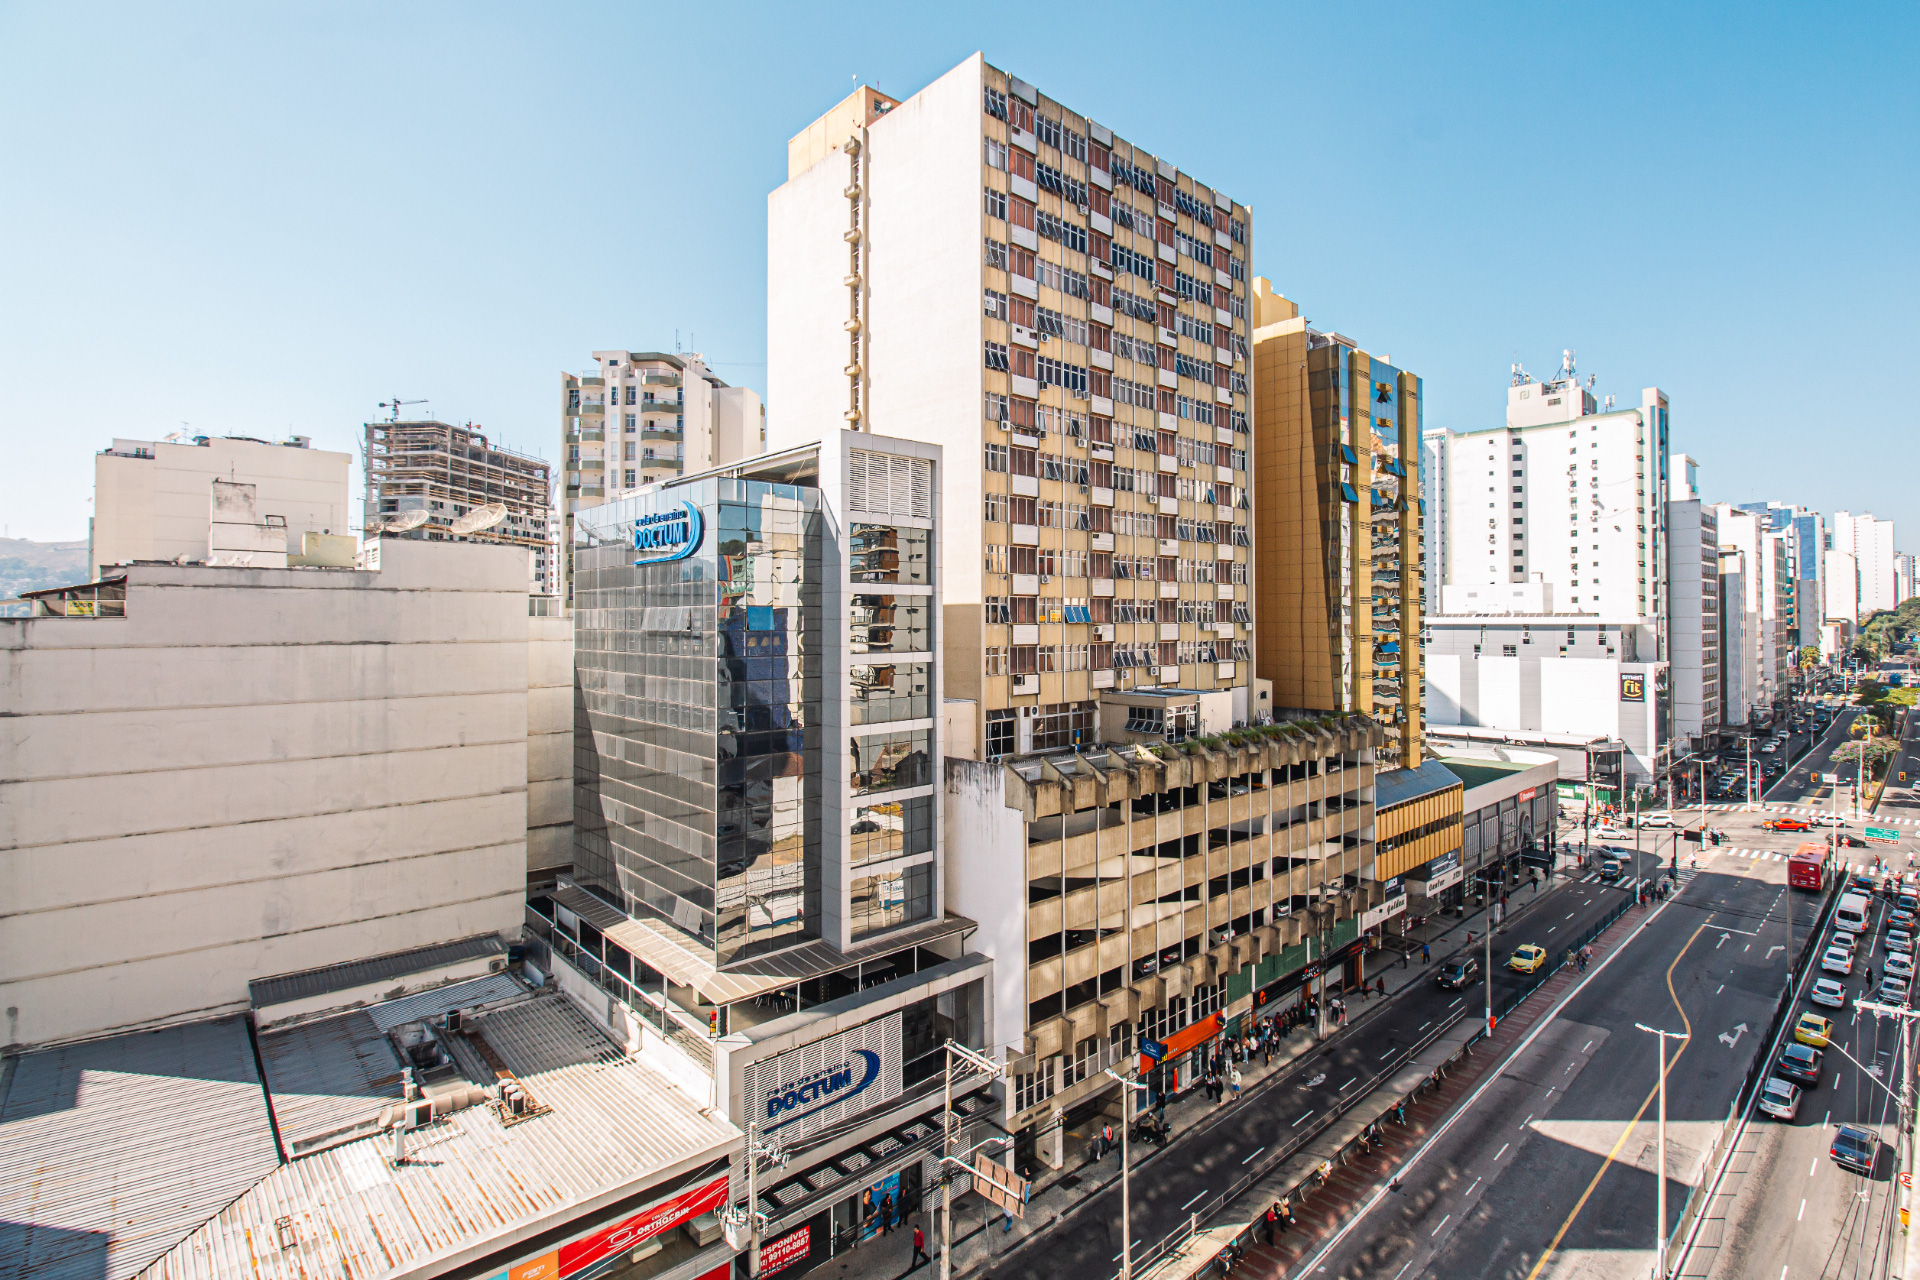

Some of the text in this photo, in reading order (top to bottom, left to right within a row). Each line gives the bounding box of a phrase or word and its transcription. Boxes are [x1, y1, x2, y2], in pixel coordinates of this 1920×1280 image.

[635, 522, 686, 550] DOCTUM
[1624, 680, 1641, 692] fit
[767, 1082, 795, 1097] rede
[797, 1076, 811, 1085] de
[767, 1068, 852, 1118] DOCTUM
